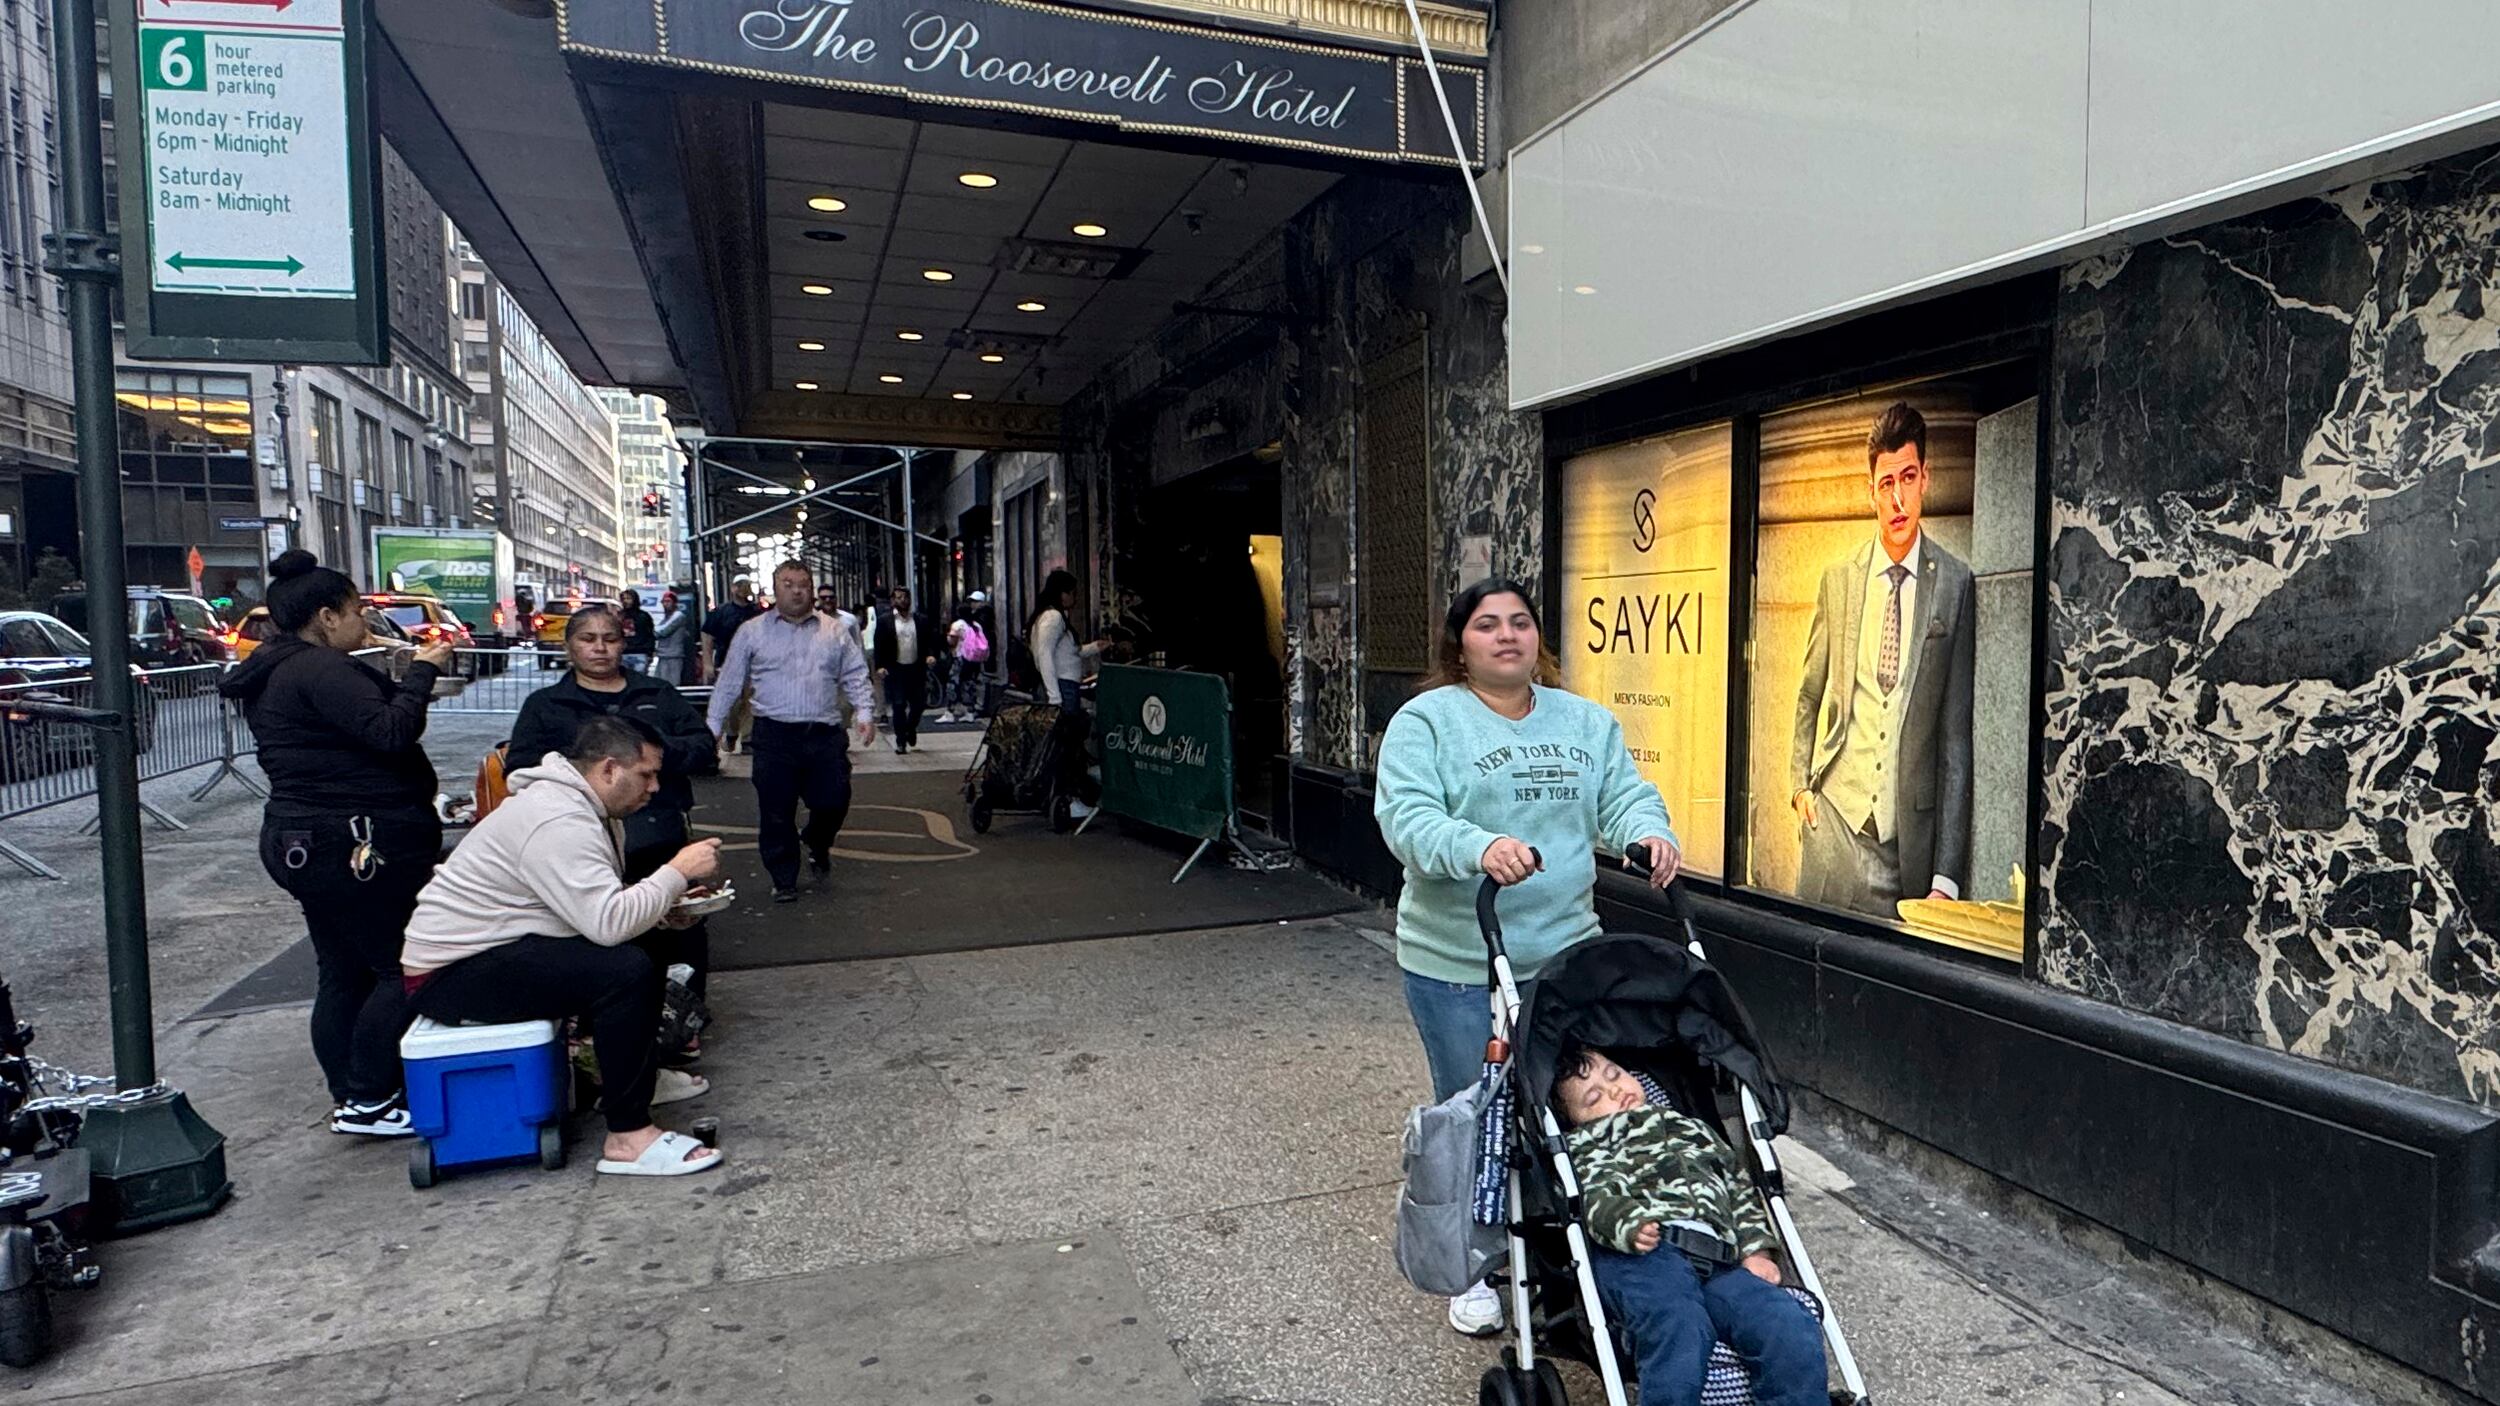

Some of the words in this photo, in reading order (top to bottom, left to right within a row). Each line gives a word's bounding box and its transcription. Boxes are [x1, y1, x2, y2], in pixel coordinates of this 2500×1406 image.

[160, 36, 193, 87] 6
[214, 42, 251, 59] hour
[216, 64, 283, 79] metered
[739, 0, 878, 63] The
[902, 9, 1177, 104] Roosevelt
[1188, 60, 1356, 129] Hotel
[217, 79, 276, 99] parking
[156, 106, 228, 131] Monday
[247, 110, 304, 135] Friday
[157, 131, 197, 154] 6pm
[214, 132, 289, 157] Midnight
[159, 165, 243, 191] Saturday
[160, 190, 199, 209] 8am
[217, 191, 292, 216] Midnight
[446, 560, 492, 576] RDS
[1588, 592, 1702, 654] SAYKI
[1614, 692, 1637, 706] MEN'S
[1638, 693, 1671, 708] FASHION
[1474, 745, 1514, 777] NEW
[1518, 743, 1566, 760] YORK
[1643, 750, 1660, 763] 1924
[1514, 787, 1542, 802] NEW
[1548, 787, 1580, 800] YORK
